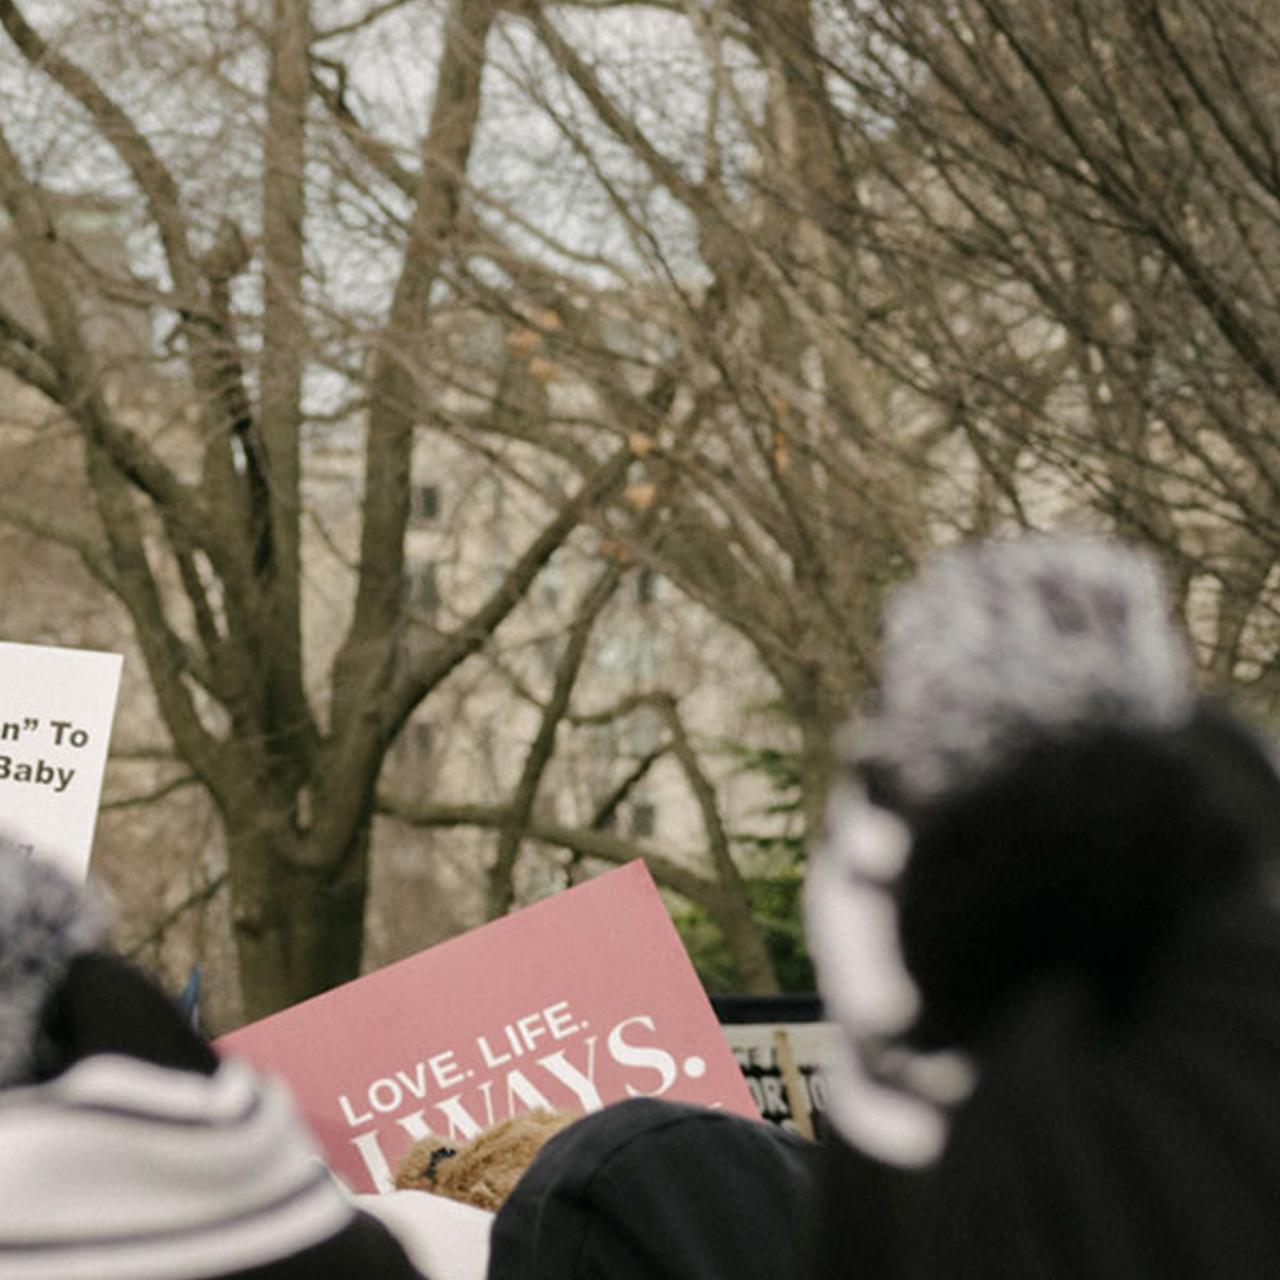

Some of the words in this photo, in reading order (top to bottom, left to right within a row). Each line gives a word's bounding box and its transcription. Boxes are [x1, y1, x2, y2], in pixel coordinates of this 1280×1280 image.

[49, 720, 89, 748] To
[338, 1050, 474, 1128] LOVE.
[475, 1000, 590, 1069] LIFE.
